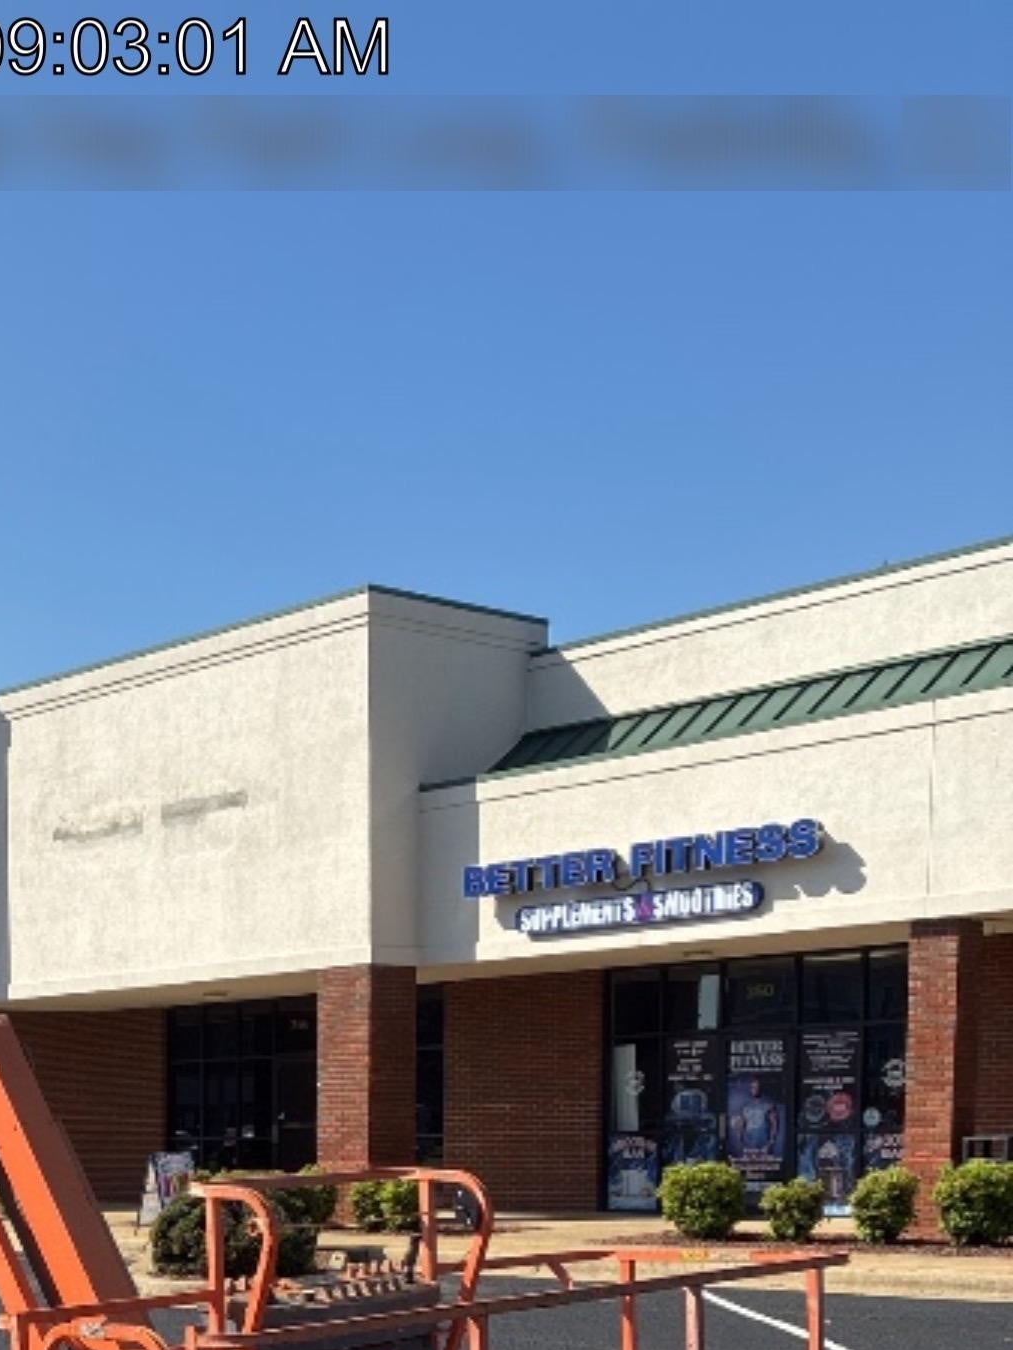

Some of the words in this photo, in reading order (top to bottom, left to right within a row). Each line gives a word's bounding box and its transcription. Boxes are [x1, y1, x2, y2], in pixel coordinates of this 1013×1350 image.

[463, 849, 618, 898] BETTER
[630, 818, 822, 878] FITNESS
[519, 895, 635, 933] SUPPLEMENTS
[651, 882, 754, 918] SMOOTHIES
